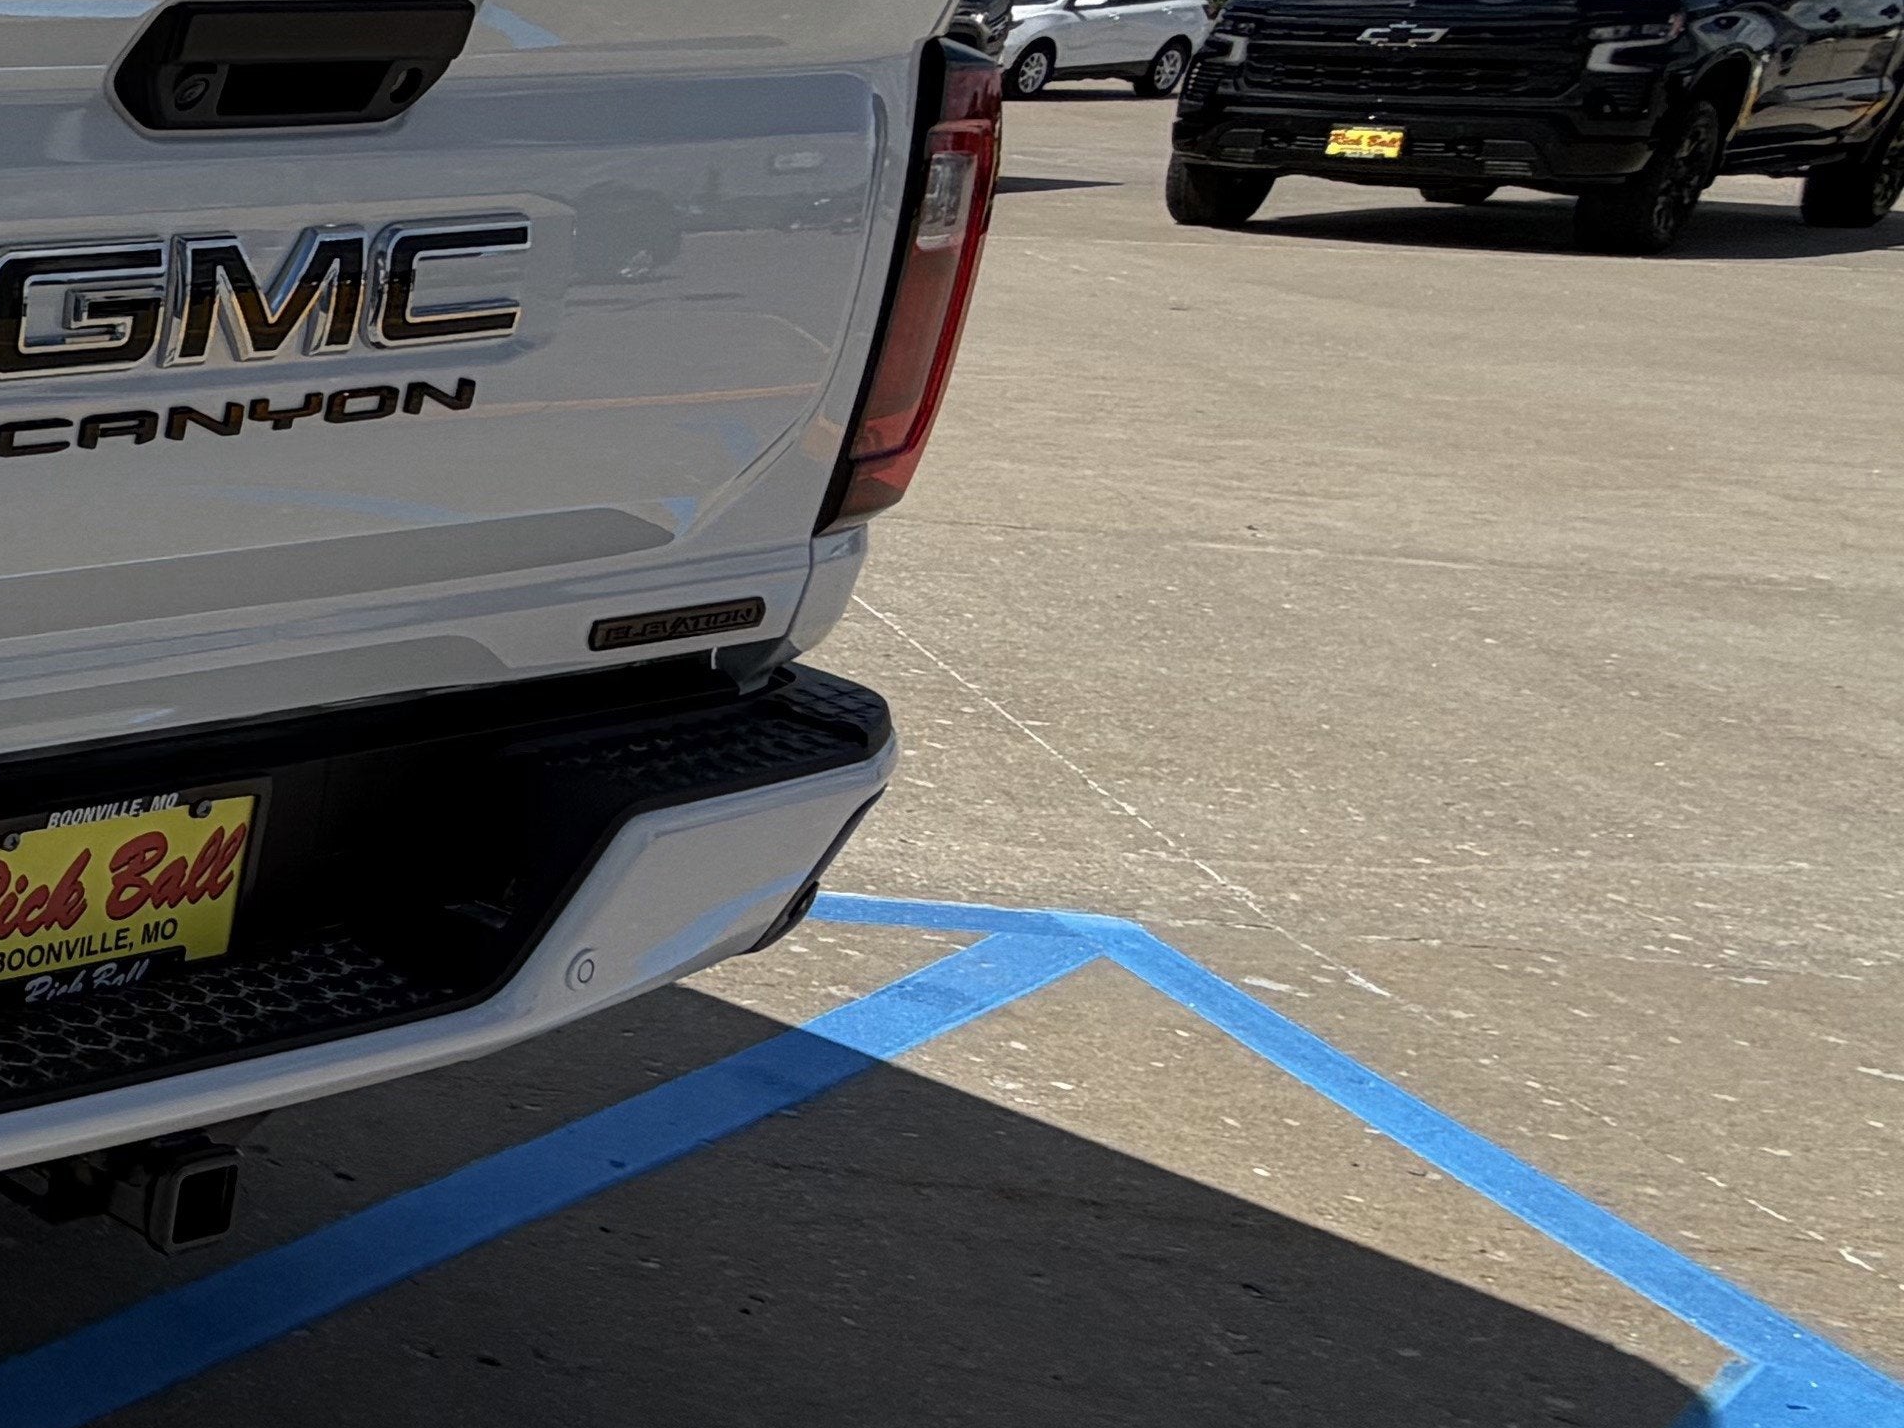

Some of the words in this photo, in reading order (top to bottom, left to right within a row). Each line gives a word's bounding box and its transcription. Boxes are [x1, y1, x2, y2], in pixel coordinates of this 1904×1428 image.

[605, 606, 754, 642] ELEVATION
[150, 792, 179, 811] MO
[104, 822, 247, 921] Ball
[141, 917, 179, 946] MO
